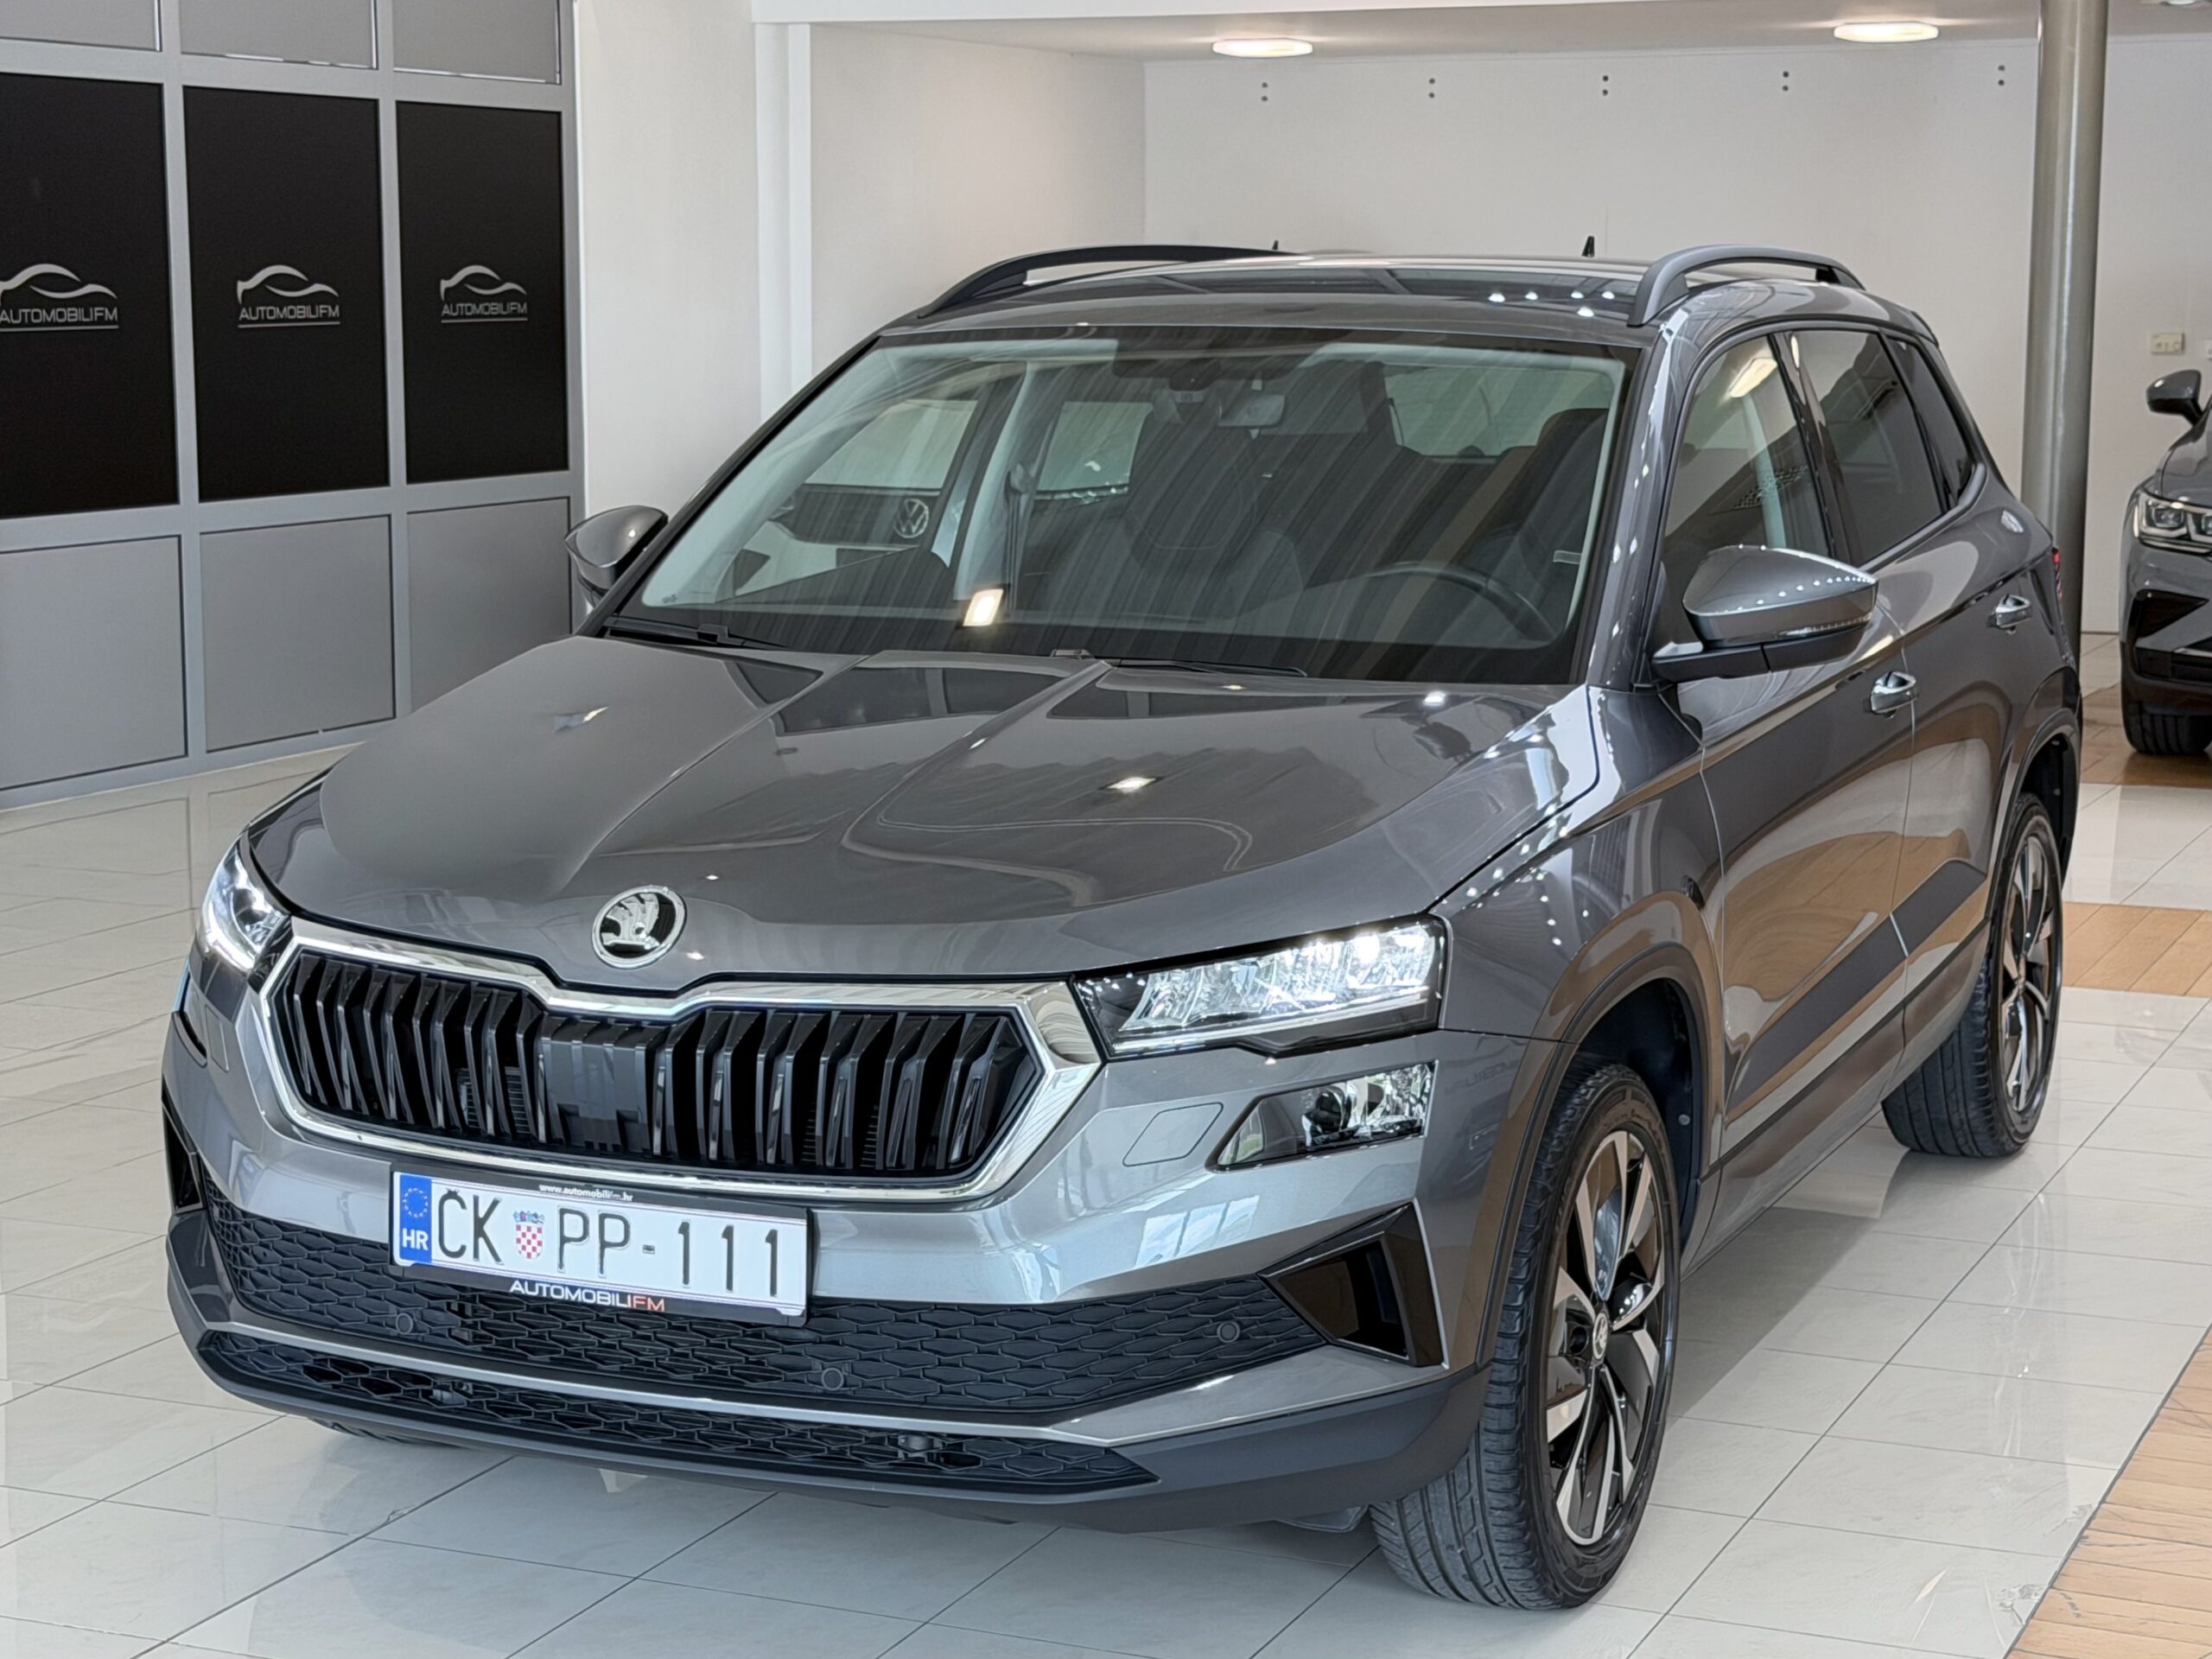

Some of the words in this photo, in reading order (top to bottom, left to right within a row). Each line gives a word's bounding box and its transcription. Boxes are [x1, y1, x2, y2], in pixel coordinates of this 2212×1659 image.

[0, 307, 118, 324] AUTOMOBILIFM
[238, 304, 340, 321] AUTOMOBILIFM
[441, 302, 528, 316] AUTOMOBILIFM
[402, 1227, 429, 1251] HR
[438, 1187, 505, 1265] ČK
[557, 1205, 779, 1297] PP-111
[508, 1279, 666, 1313] AUTOMOBILIFM
